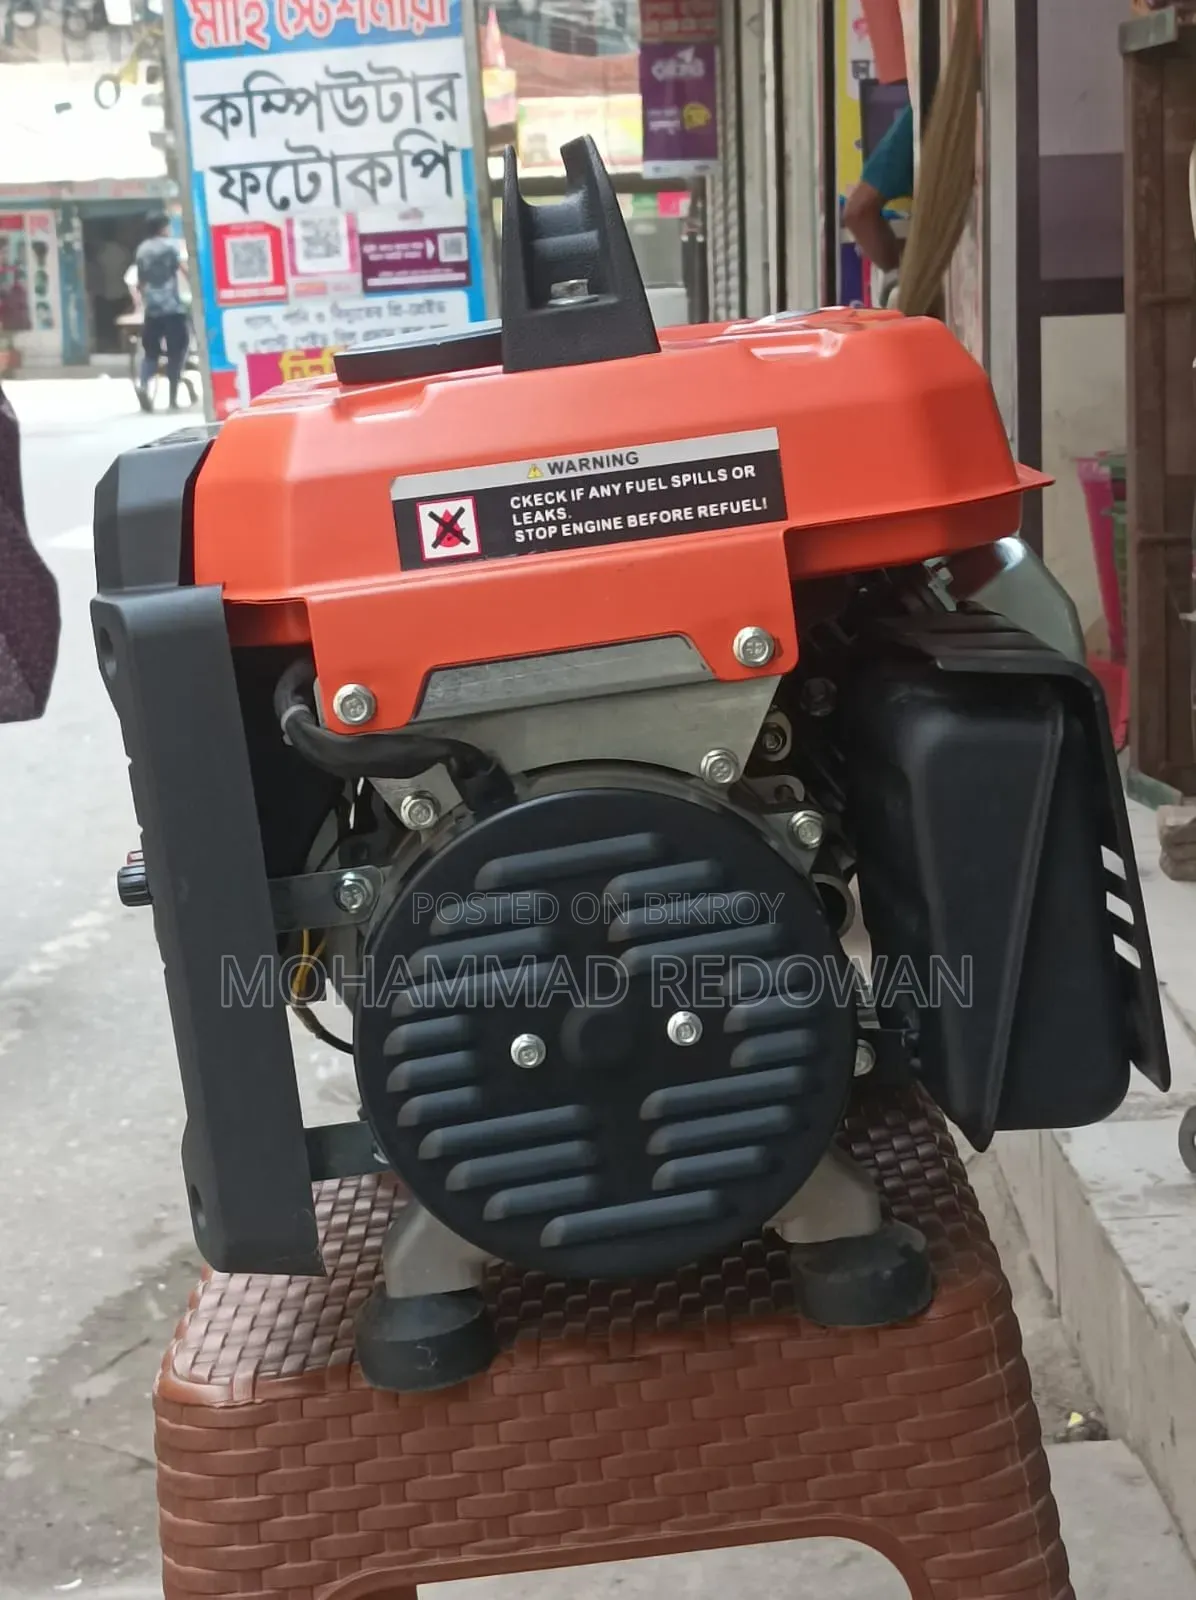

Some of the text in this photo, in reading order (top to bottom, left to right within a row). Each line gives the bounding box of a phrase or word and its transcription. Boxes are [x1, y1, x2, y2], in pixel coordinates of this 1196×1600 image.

[193, 61, 462, 141] কম্পিউটার
[209, 128, 457, 214] ফটোকপি
[547, 451, 639, 476] WARNING
[510, 464, 756, 509] CKECK IF ANY FUEL SPILLS OR
[512, 507, 573, 526] LEAKS.
[515, 497, 768, 543] STOP ENGINE BEFORE REFUEL!
